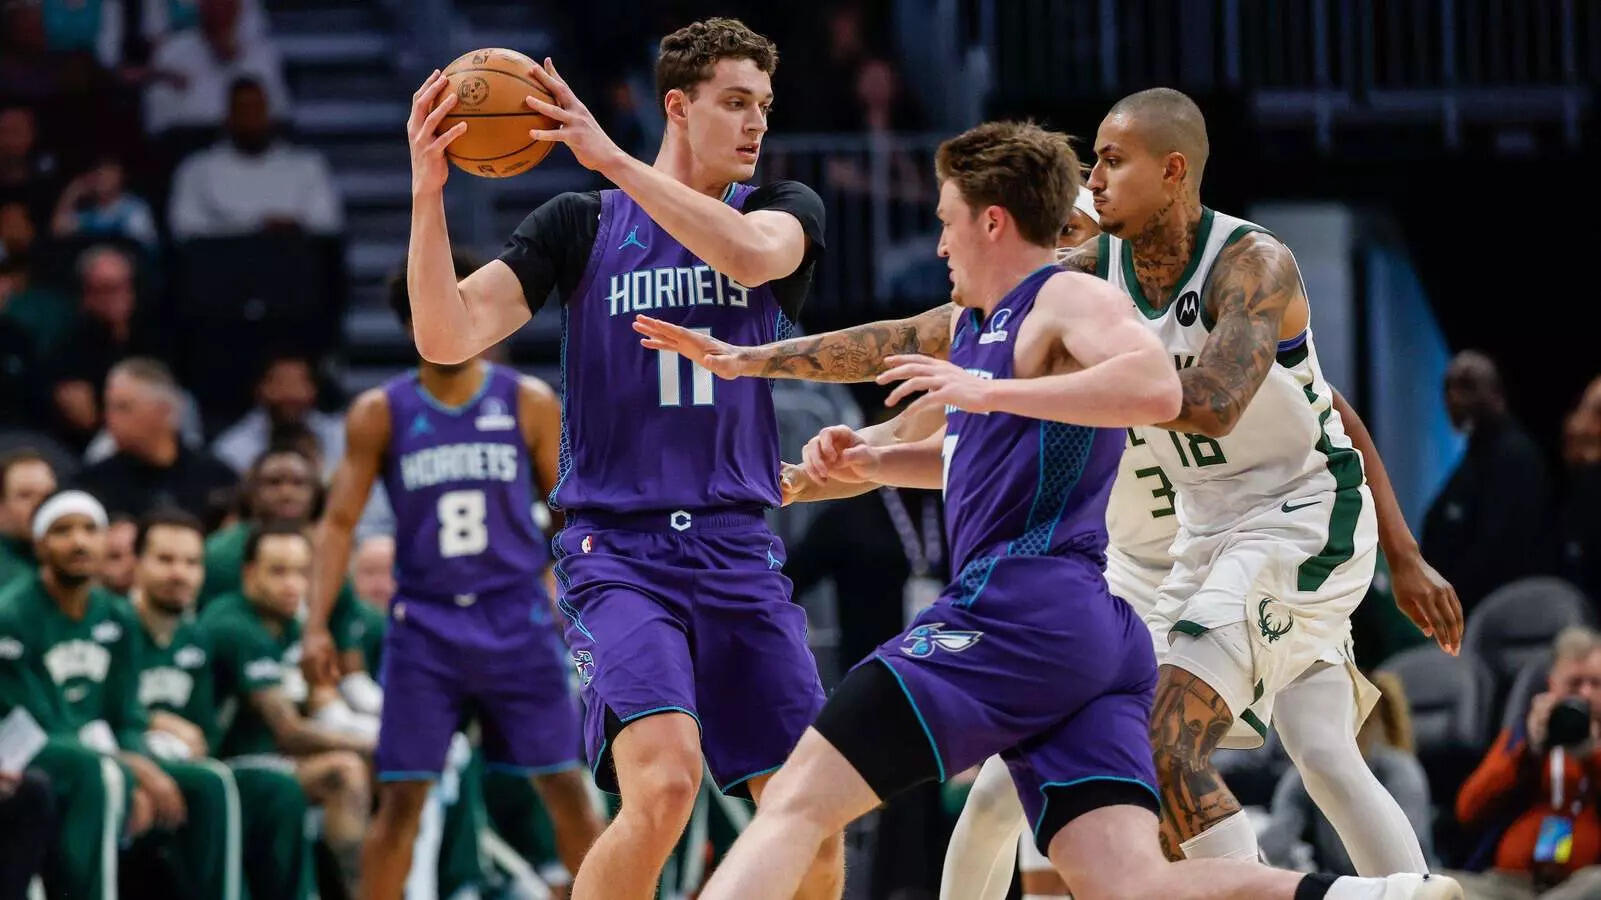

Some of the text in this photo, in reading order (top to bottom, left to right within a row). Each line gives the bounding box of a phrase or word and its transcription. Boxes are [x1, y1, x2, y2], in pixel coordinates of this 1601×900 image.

[605, 265, 751, 316] HORNETS
[659, 327, 714, 407] 11
[401, 443, 517, 491] HORNETS
[1135, 465, 1176, 519] 3
[437, 489, 488, 559] 8
